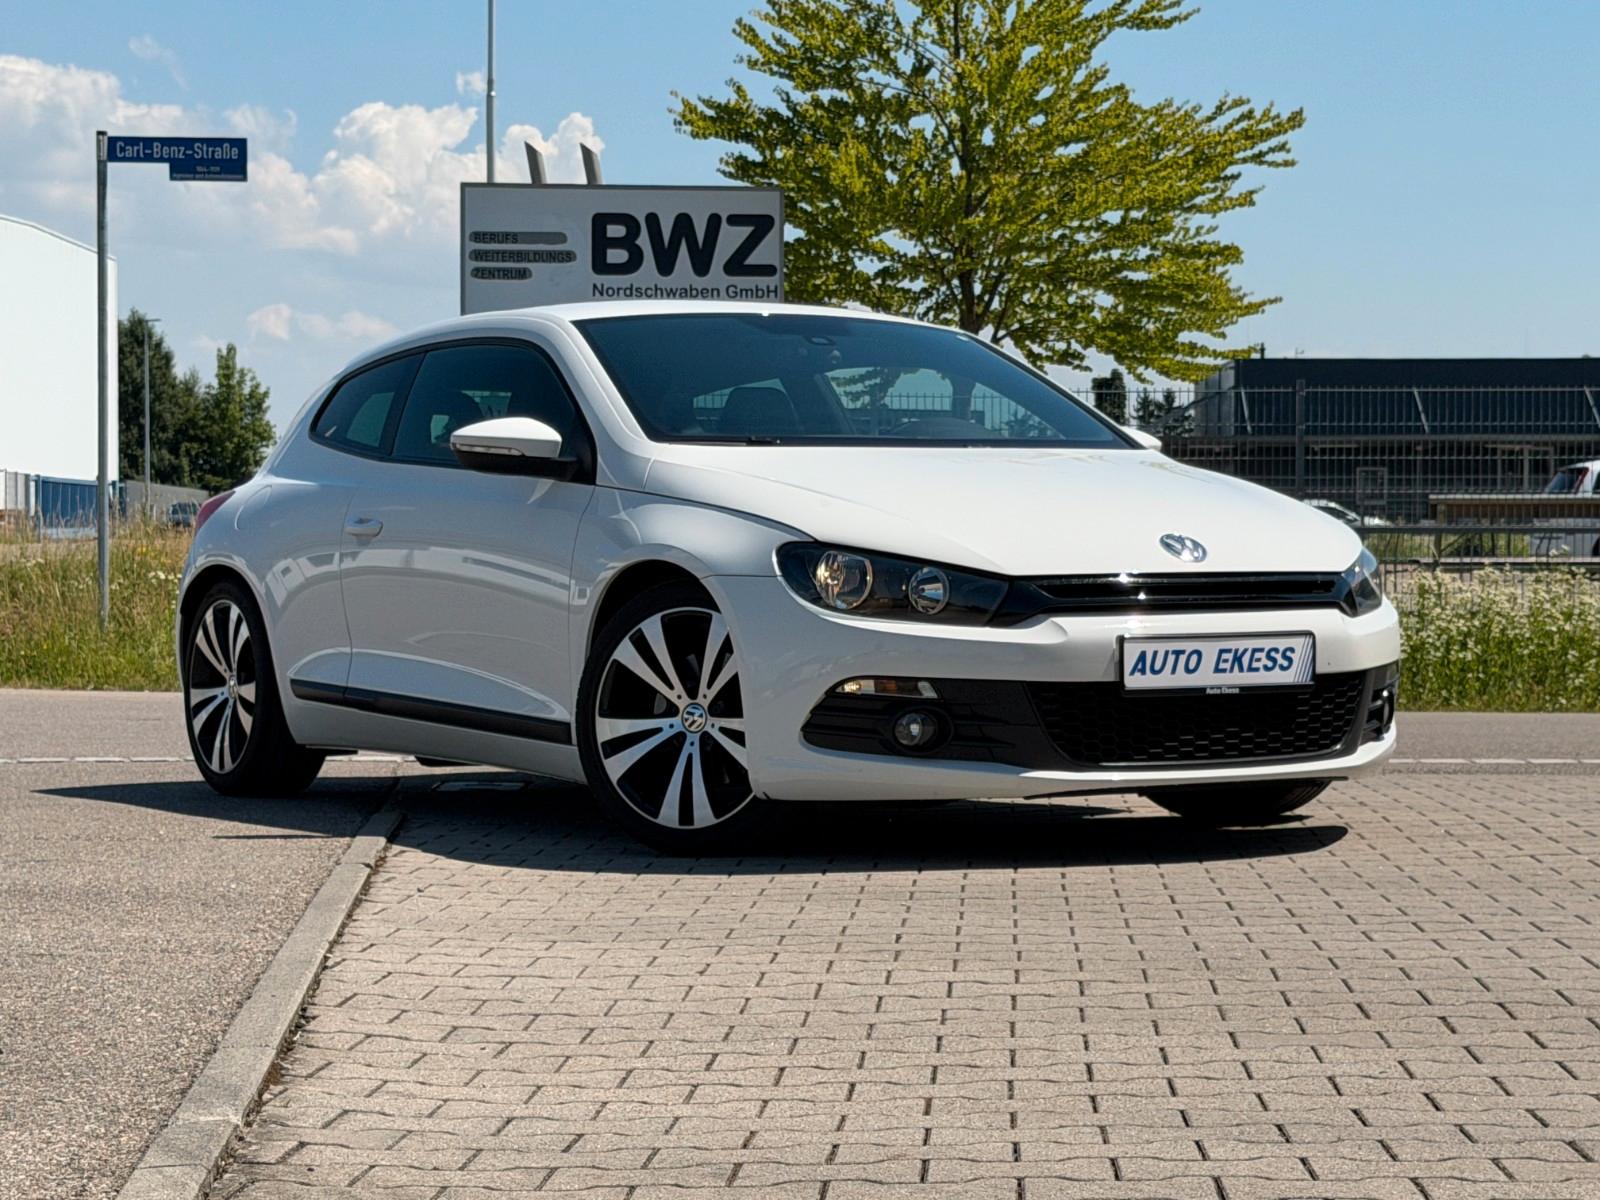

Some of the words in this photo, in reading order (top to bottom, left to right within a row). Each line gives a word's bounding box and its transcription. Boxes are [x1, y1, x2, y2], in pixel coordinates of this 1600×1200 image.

[116, 141, 239, 159] Carl-Benz-Straße
[474, 232, 519, 244] BERUFS
[591, 212, 778, 277] BWZ
[474, 251, 573, 264] WEITERBILDUNGS
[474, 268, 528, 280] ZENTRUM
[592, 283, 720, 299] Nordschwaben
[725, 284, 779, 299] GmbH
[1129, 650, 1203, 676] AUTO
[1213, 646, 1296, 674] EKESS
